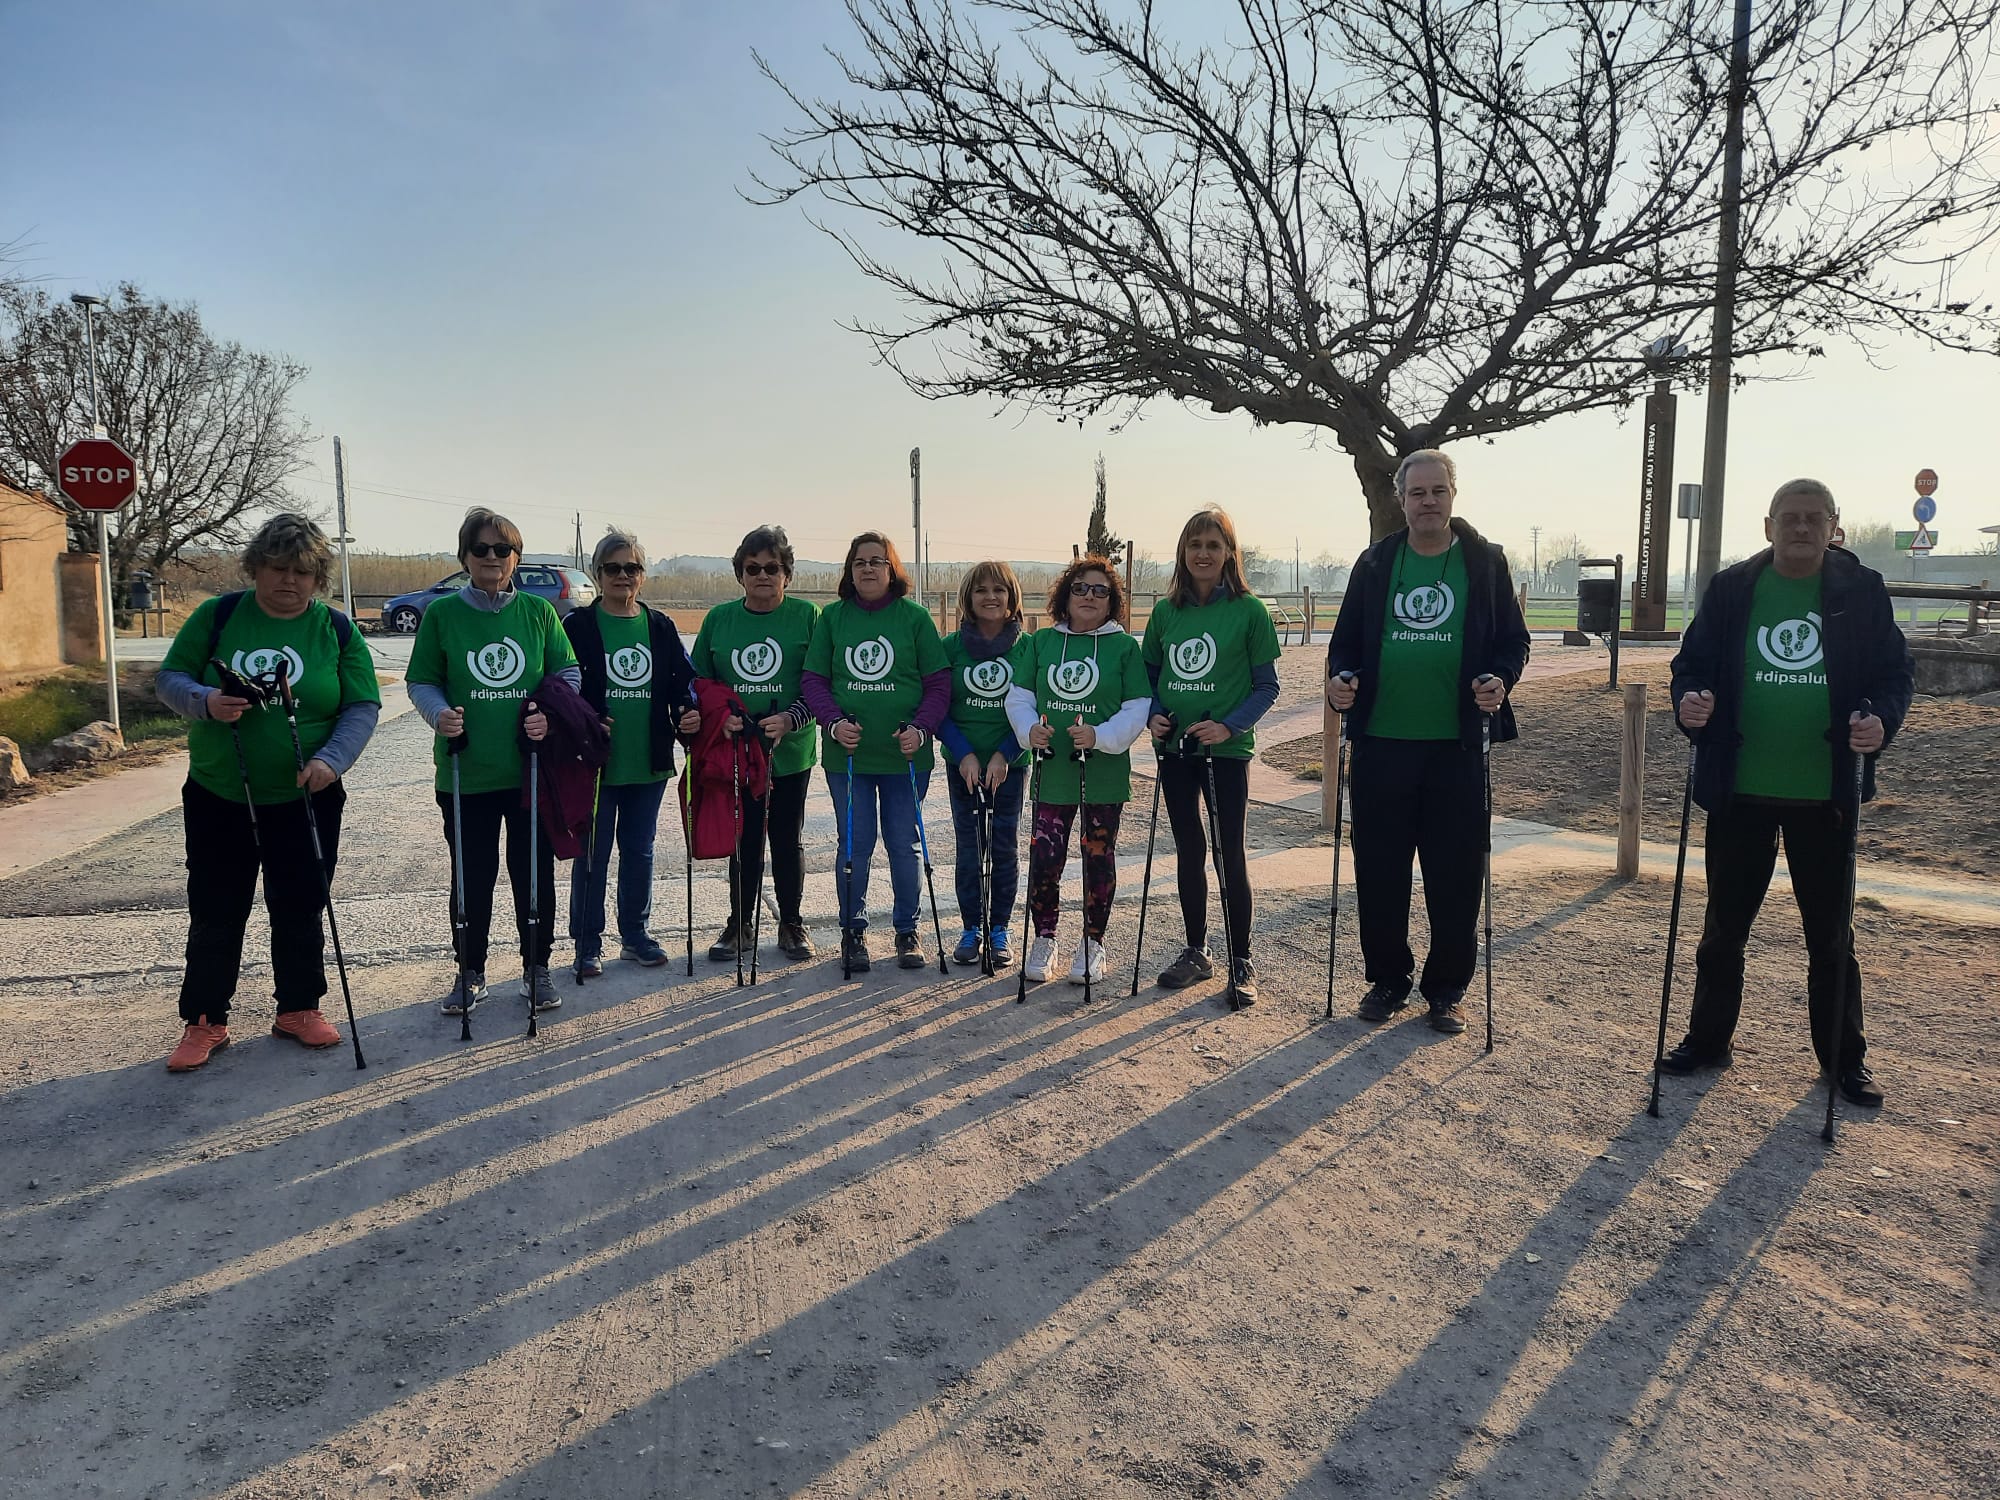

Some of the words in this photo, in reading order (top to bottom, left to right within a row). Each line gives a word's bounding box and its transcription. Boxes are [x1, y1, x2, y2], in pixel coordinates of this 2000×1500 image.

[1647, 423, 1656, 458] TREVA
[64, 466, 131, 484] STOP
[1646, 464, 1654, 485] PAU
[1645, 487, 1653, 501] DE
[1643, 502, 1652, 537] TERRA
[1640, 538, 1650, 599] RIUDELLOTS
[1391, 630, 1453, 643] #dipsalut
[1755, 670, 1829, 685] #dipsalut
[733, 683, 783, 694] #dipsalut
[847, 681, 896, 693] #dipsalut
[1167, 680, 1216, 693] #dipsalut
[470, 688, 529, 701] #dipsalut
[605, 688, 652, 700] #dipsalu
[966, 697, 1004, 709] #dipsal
[1046, 700, 1097, 713] #dipsalut
